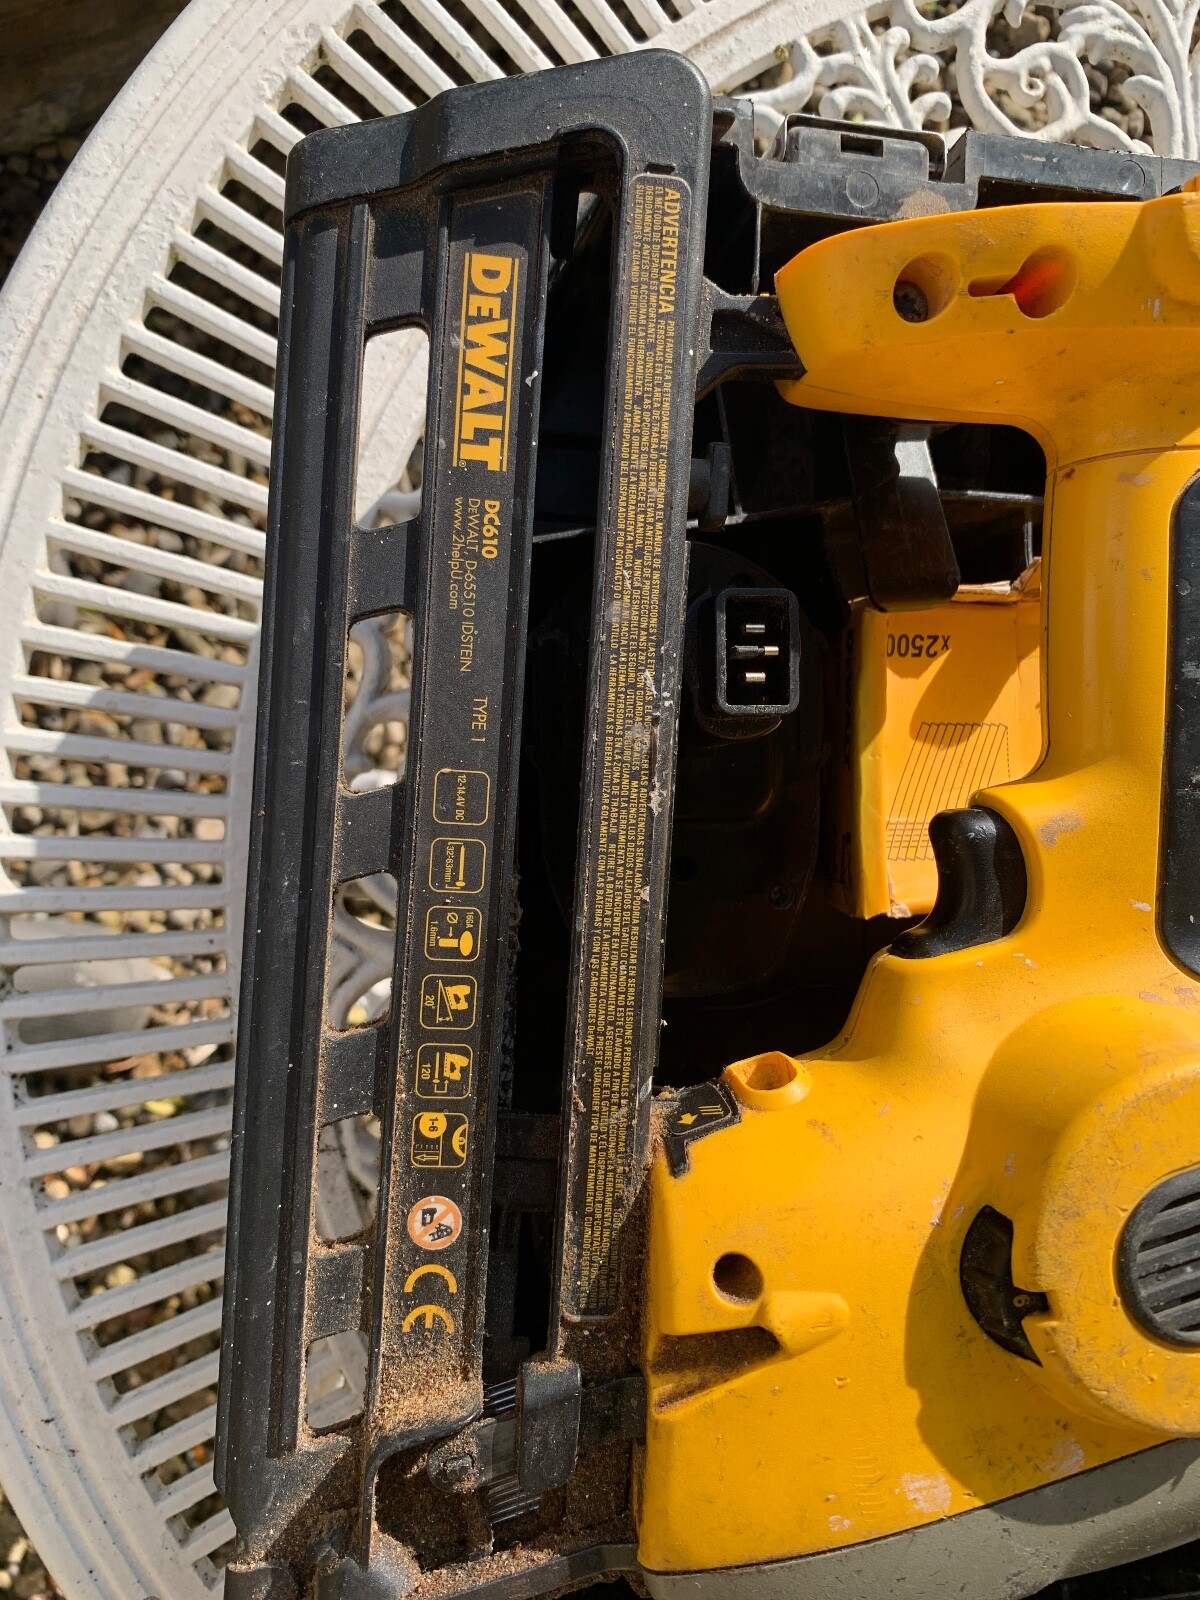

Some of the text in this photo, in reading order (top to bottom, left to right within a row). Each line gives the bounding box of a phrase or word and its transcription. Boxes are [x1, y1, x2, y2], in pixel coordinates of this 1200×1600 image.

[655, 186, 663, 194] EL
[633, 184, 644, 239] SUJETADORES
[642, 185, 653, 241] DEBIDAMENTE
[652, 232, 660, 242] DE
[657, 187, 681, 314] ADVERTENCIA
[631, 249, 640, 282] CUANDO
[641, 243, 650, 269] ANTES
[650, 244, 660, 278] DISPARO
[640, 271, 648, 281] DE
[650, 280, 658, 289] ES
[628, 285, 638, 324] VERIFIQUE
[638, 283, 648, 324] ACCIONAR
[628, 327, 635, 335] EL
[637, 326, 645, 336] LA
[656, 319, 665, 361] PERSONAS
[666, 320, 674, 335] POR
[664, 338, 673, 363] FAVOR
[623, 337, 635, 409] FUNCIONAMIENTO
[634, 338, 645, 397] HERRAMIENTA.
[644, 351, 653, 391] CONSULTE
[654, 376, 661, 384] EL
[655, 363, 662, 373] EN
[663, 366, 671, 379] LEA
[643, 394, 651, 409] LAS
[652, 410, 659, 419] DE
[659, 382, 670, 449] DETENIDAMENTE
[620, 412, 631, 458] APROPIADO
[640, 411, 650, 451] OPCIONES
[650, 422, 659, 458] TRABAJO
[630, 435, 639, 469] ORIENTE
[639, 453, 647, 469] QUE
[619, 461, 628, 475] DEL
[629, 471, 637, 481] LA
[638, 472, 646, 500] OFRECE
[656, 459, 666, 508] COMPRENDA
[616, 477, 627, 528] DISPARADOR
[625, 484, 636, 541] HERRAMIENTA
[637, 503, 645, 511] EL
[646, 495, 654, 522] LLEVAR
[655, 511, 663, 519] EL
[481, 499, 500, 558] DC610
[615, 531, 624, 547] POR
[635, 514, 644, 550] MANUAL.
[653, 522, 662, 556] MANUAL
[445, 497, 466, 609] www.2helpU.com
[624, 543, 633, 567] HACIA
[644, 525, 653, 565] ANTEOJOS
[613, 549, 623, 590] CONTACTO
[633, 559, 641, 586] NUNCA
[643, 568, 650, 577] DE
[652, 558, 660, 568] DE
[462, 560, 477, 616] D-65510
[648, 570, 659, 632] INSTRUCCIONES
[621, 610, 629, 618] NI
[630, 589, 639, 639] DESHABILITE
[459, 621, 473, 672] IDSTEIN
[620, 621, 628, 645] HACIA
[629, 641, 636, 650] EL
[639, 630, 647, 648] ANSI
[609, 655, 617, 665] LA
[619, 647, 627, 661] LAS
[647, 642, 655, 656] LAS
[627, 652, 636, 685] SEGURO.
[606, 667, 616, 722] HERRAMIENTA
[625, 689, 634, 717] UTILICE
[634, 690, 643, 726] GUARDAS
[471, 696, 487, 730] TYPE
[614, 693, 624, 735] PERSONAS
[644, 704, 651, 714] EL
[605, 724, 613, 734] SE
[624, 719, 632, 728] EL
[613, 749, 621, 759] LA
[614, 737, 621, 747] EN
[622, 730, 631, 760] SEGURO
[612, 761, 620, 783] ZONA
[620, 763, 629, 795] CUANDO
[454, 774, 466, 820] 12-14.4V DC
[601, 769, 610, 804] UTILIZAR
[611, 785, 619, 795] DE
[620, 797, 627, 807] LA
[628, 780, 637, 824] MANTENGA
[636, 787, 646, 845] ADVERTENCIAS
[598, 805, 608, 852] SOLAMENTE
[609, 798, 618, 835] TRABAJO.
[616, 809, 627, 864] HERRAMIENTA
[627, 825, 635, 840] LOS
[444, 845, 454, 882] 32-63mm
[597, 854, 605, 871] CON
[606, 843, 615, 869] RETIRE
[625, 842, 634, 867] DEDOS
[596, 872, 604, 887] LAS
[606, 871, 613, 880] LA
[615, 866, 623, 877] NO
[615, 879, 622, 889] SE
[623, 869, 632, 909] ALEJADOS
[465, 911, 473, 928] 16GA
[603, 917, 610, 927] DE
[612, 891, 621, 936] ENCUENTRE
[428, 920, 438, 946] 1.6mm
[592, 936, 600, 952] CON
[602, 929, 610, 939] LA
[611, 938, 619, 949] EN
[620, 927, 628, 957] GATILLO
[629, 926, 638, 964] RESULTAR
[598, 941, 609, 996] HERRAMIENTA
[617, 959, 626, 991] CUANDO
[628, 965, 636, 976] EN
[587, 971, 598, 1023] CARGADORES
[606, 950, 618, 1023] FUNCIONAMIENTO.
[616, 993, 624, 1005] NO
[626, 978, 635, 1006] SERIAS
[596, 998, 605, 1034] CUANDO:
[624, 1007, 633, 1044] LESIONES
[594, 1036, 603, 1064] PRESTE
[613, 1027, 622, 1069] CLAVANDO
[420, 1063, 431, 1079] 120
[602, 1072, 610, 1088] QUE
[620, 1046, 630, 1096] PERSONALES
[591, 1066, 601, 1111] CUALQUIER
[601, 1090, 609, 1098] EL
[610, 1093, 618, 1103] DE
[428, 1116, 439, 1132] 1-6
[590, 1112, 598, 1130] TIPO
[599, 1100, 609, 1131] GATILLO
[589, 1132, 597, 1142] DE
[607, 1119, 616, 1159] ACCIONAR
[606, 1160, 614, 1171] LA
[594, 1202, 602, 1219] POR
[603, 1171, 613, 1227] HERRAMIENTA
[582, 1216, 591, 1249] CUANDO
[592, 1220, 601, 1261] CONTACTO
[401, 1264, 458, 1333] CE
